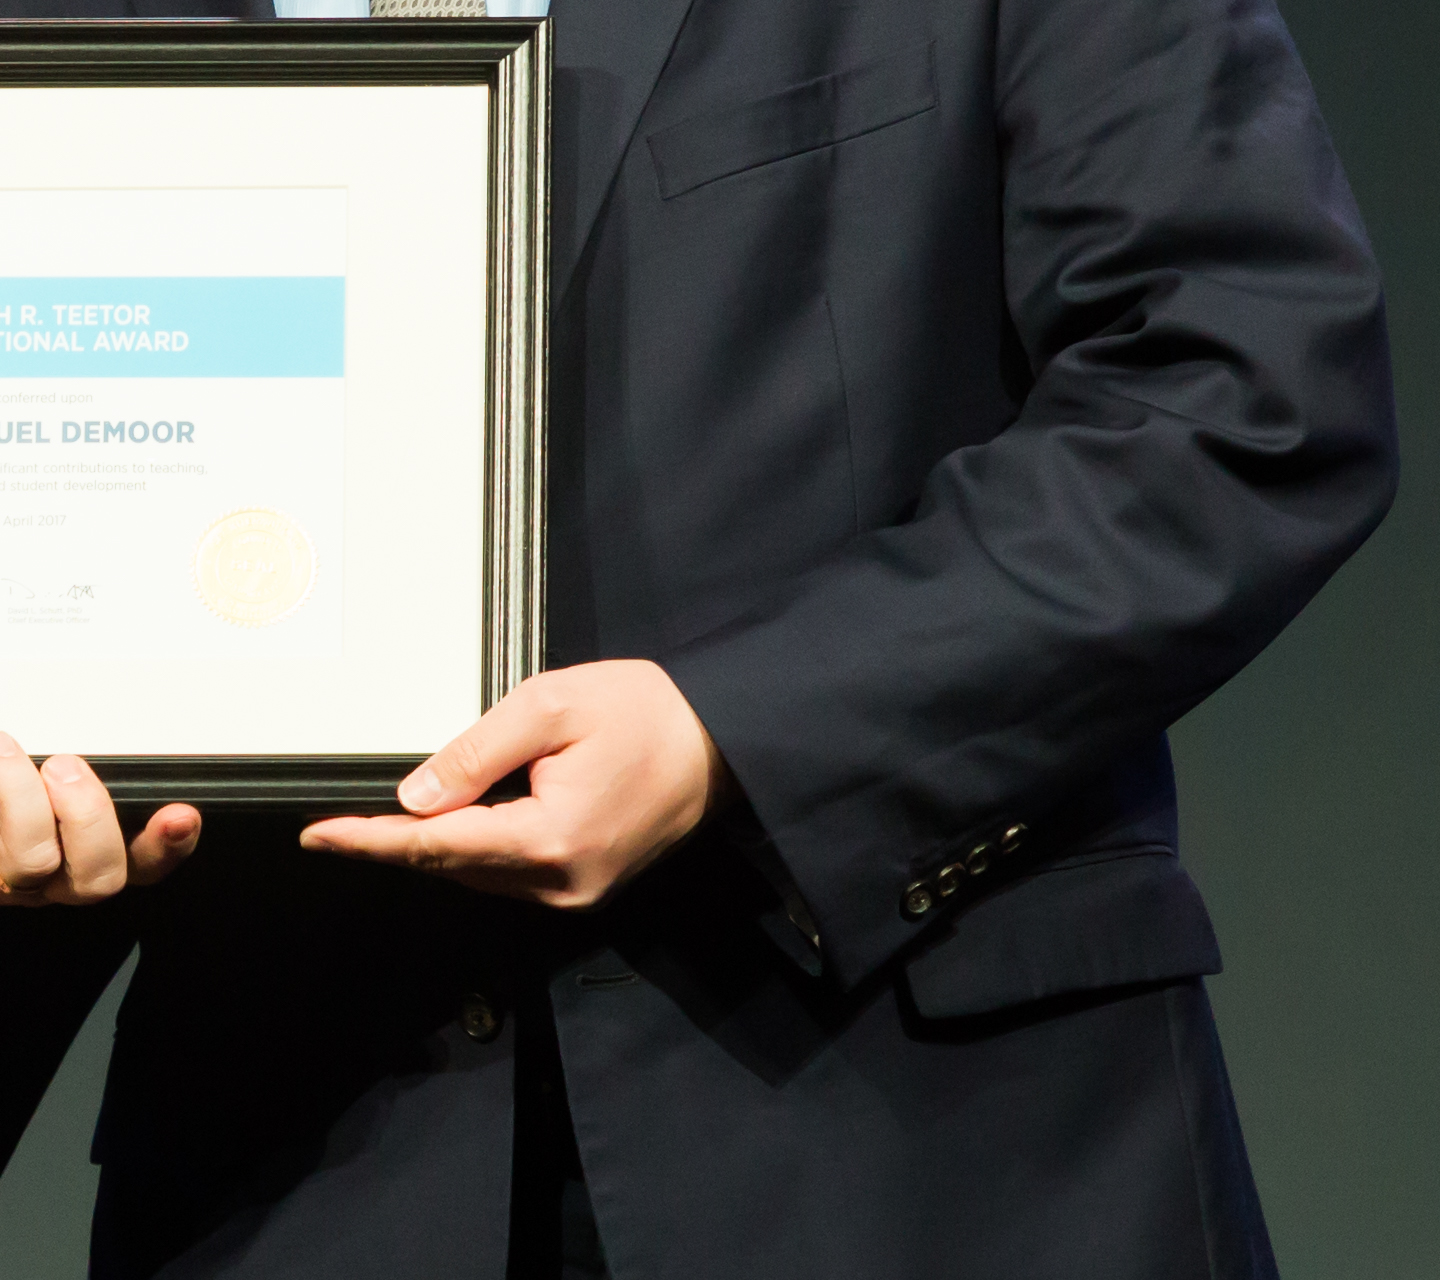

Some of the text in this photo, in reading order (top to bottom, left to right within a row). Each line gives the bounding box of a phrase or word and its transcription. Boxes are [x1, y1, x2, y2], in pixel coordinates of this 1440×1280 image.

[20, 304, 44, 326] R.
[52, 304, 151, 326] TEETOR
[93, 330, 189, 352] AWARD
[61, 393, 94, 407] upon
[61, 420, 195, 444] DEMOOR
[42, 461, 129, 475] contributions
[132, 462, 146, 475] to
[149, 461, 209, 477] teaching,
[9, 479, 59, 492] student
[62, 478, 148, 495] development
[2, 513, 68, 529] April 2017
